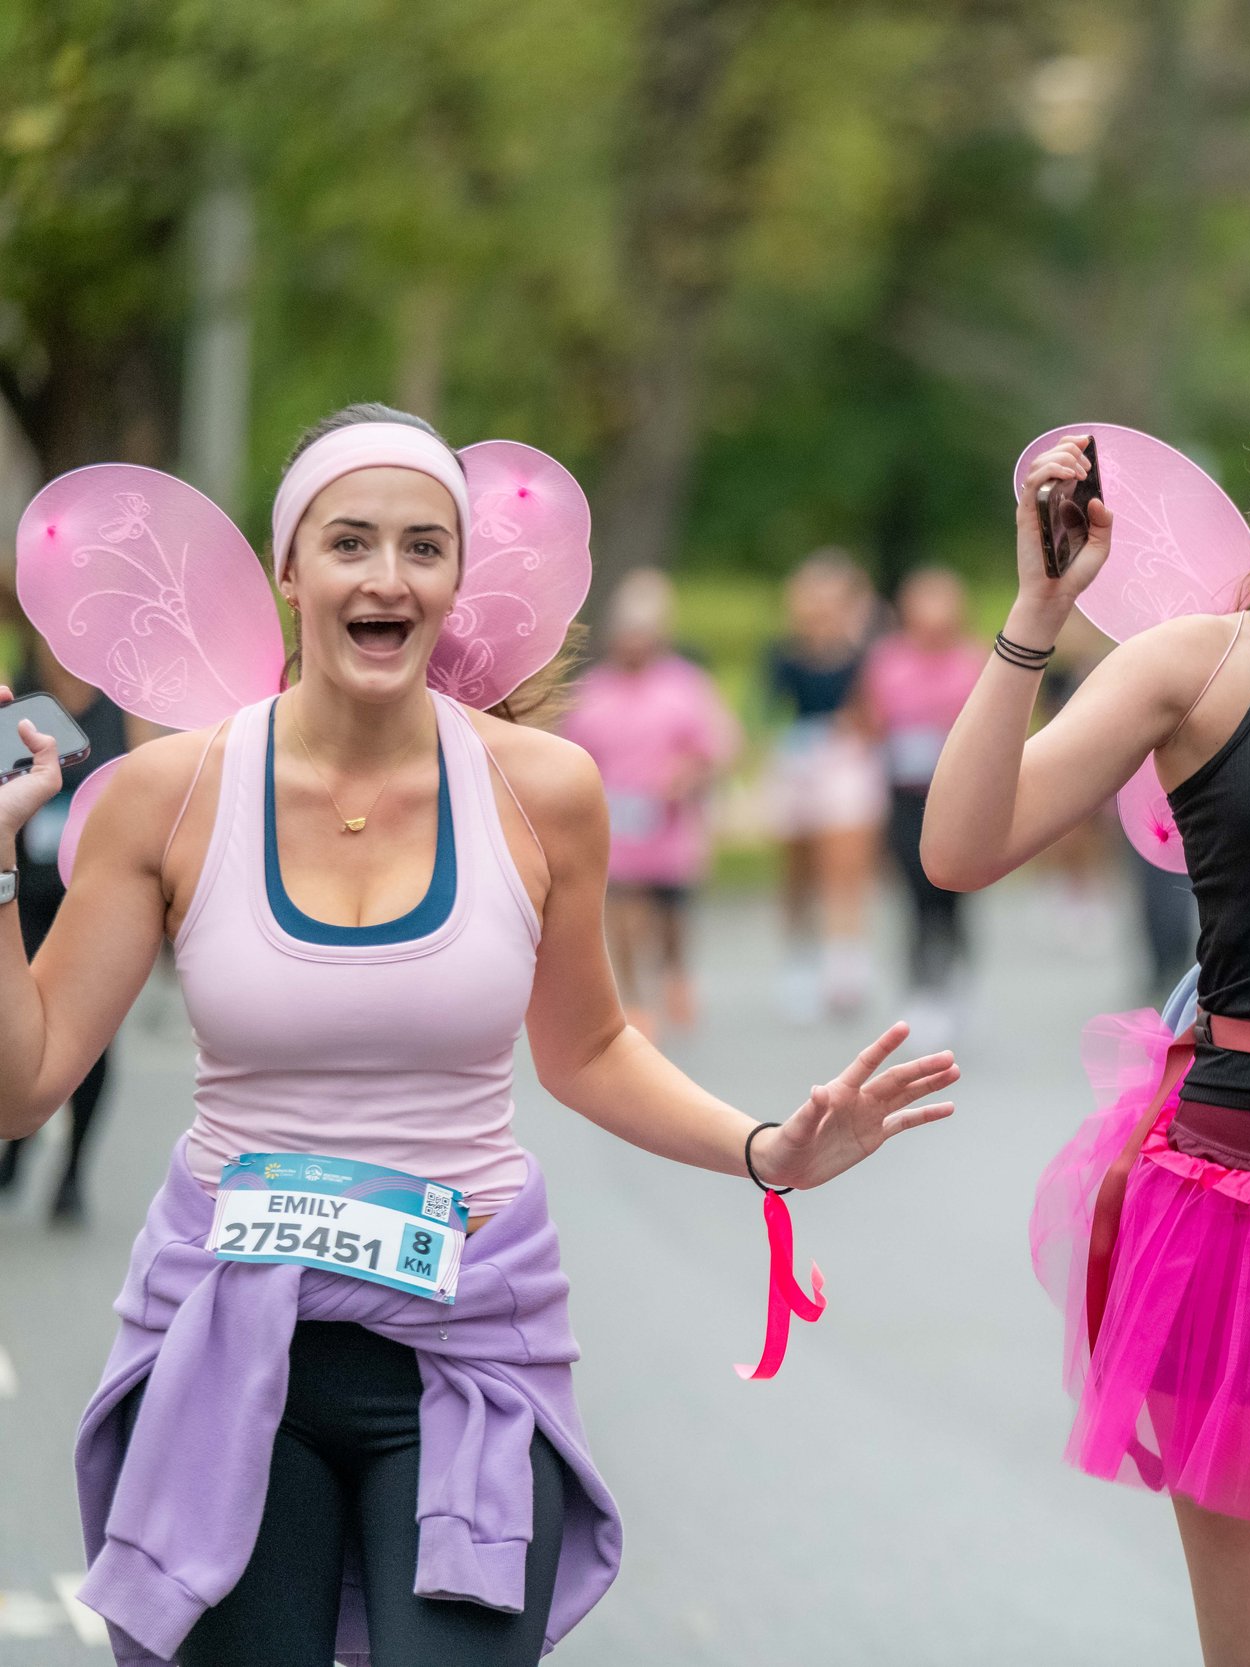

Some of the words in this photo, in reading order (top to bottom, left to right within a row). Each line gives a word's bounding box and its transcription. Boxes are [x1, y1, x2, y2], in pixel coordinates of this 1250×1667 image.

[267, 1195, 349, 1219] EMILY
[220, 1222, 382, 1271] 275451
[413, 1231, 433, 1255] 8
[404, 1256, 432, 1277] KM
